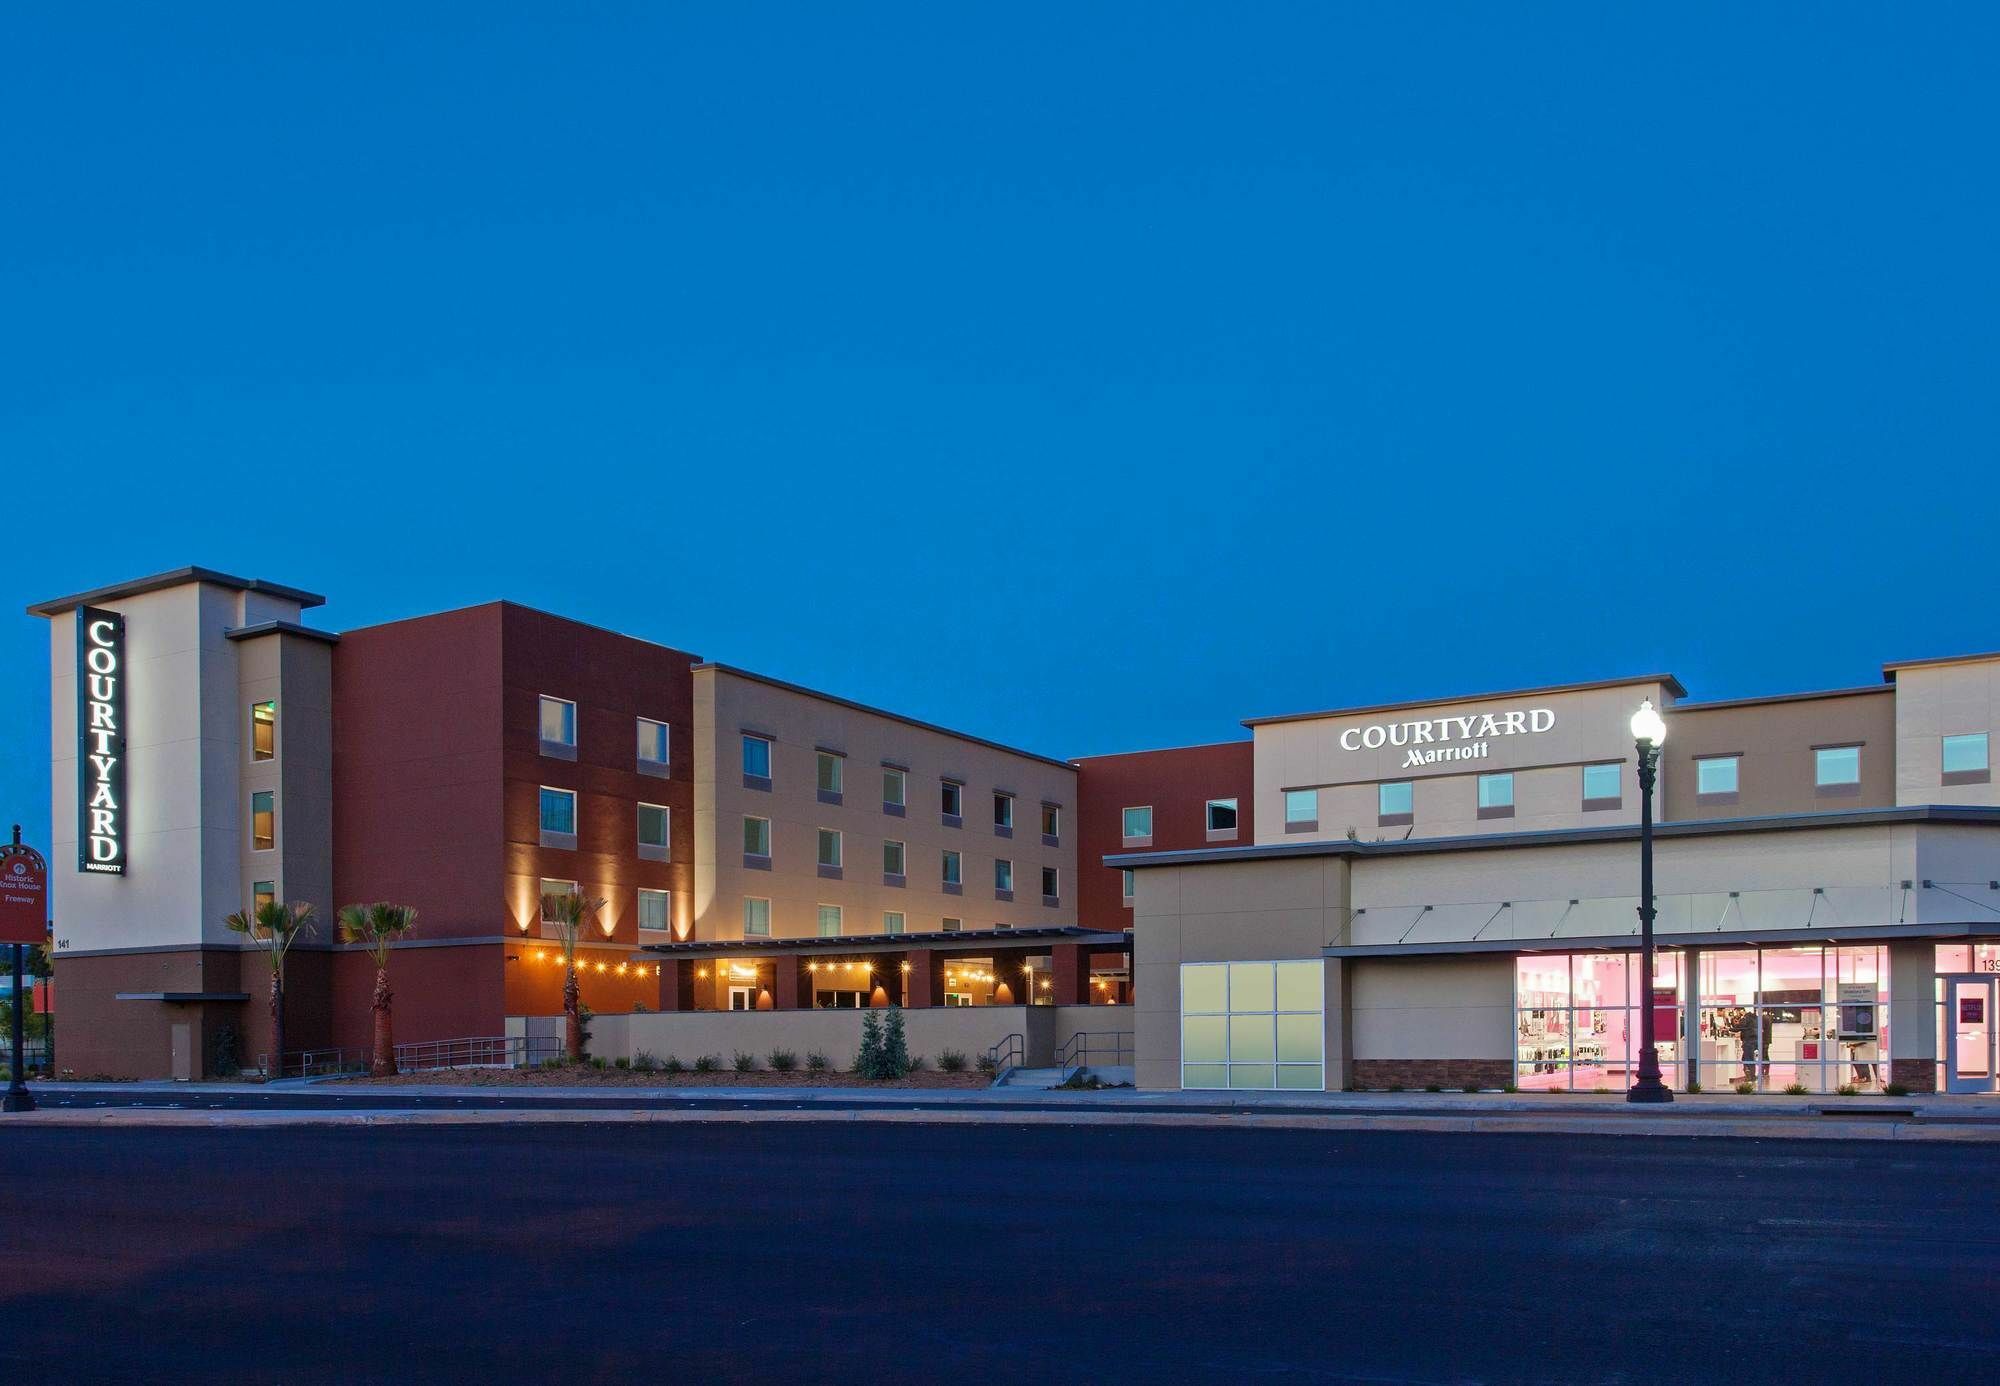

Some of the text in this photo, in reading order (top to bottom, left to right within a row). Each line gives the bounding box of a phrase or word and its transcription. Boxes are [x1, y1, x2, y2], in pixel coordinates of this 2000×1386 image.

[1340, 708, 1556, 751] COURTYARD
[88, 620, 118, 862] COURTYARD
[1401, 741, 1489, 769] Marriott
[86, 863, 121, 872] MARRIOTT
[5, 874, 34, 883] Historic
[18, 882, 41, 891] House
[5, 894, 35, 905] Freeway
[58, 939, 70, 949] 141
